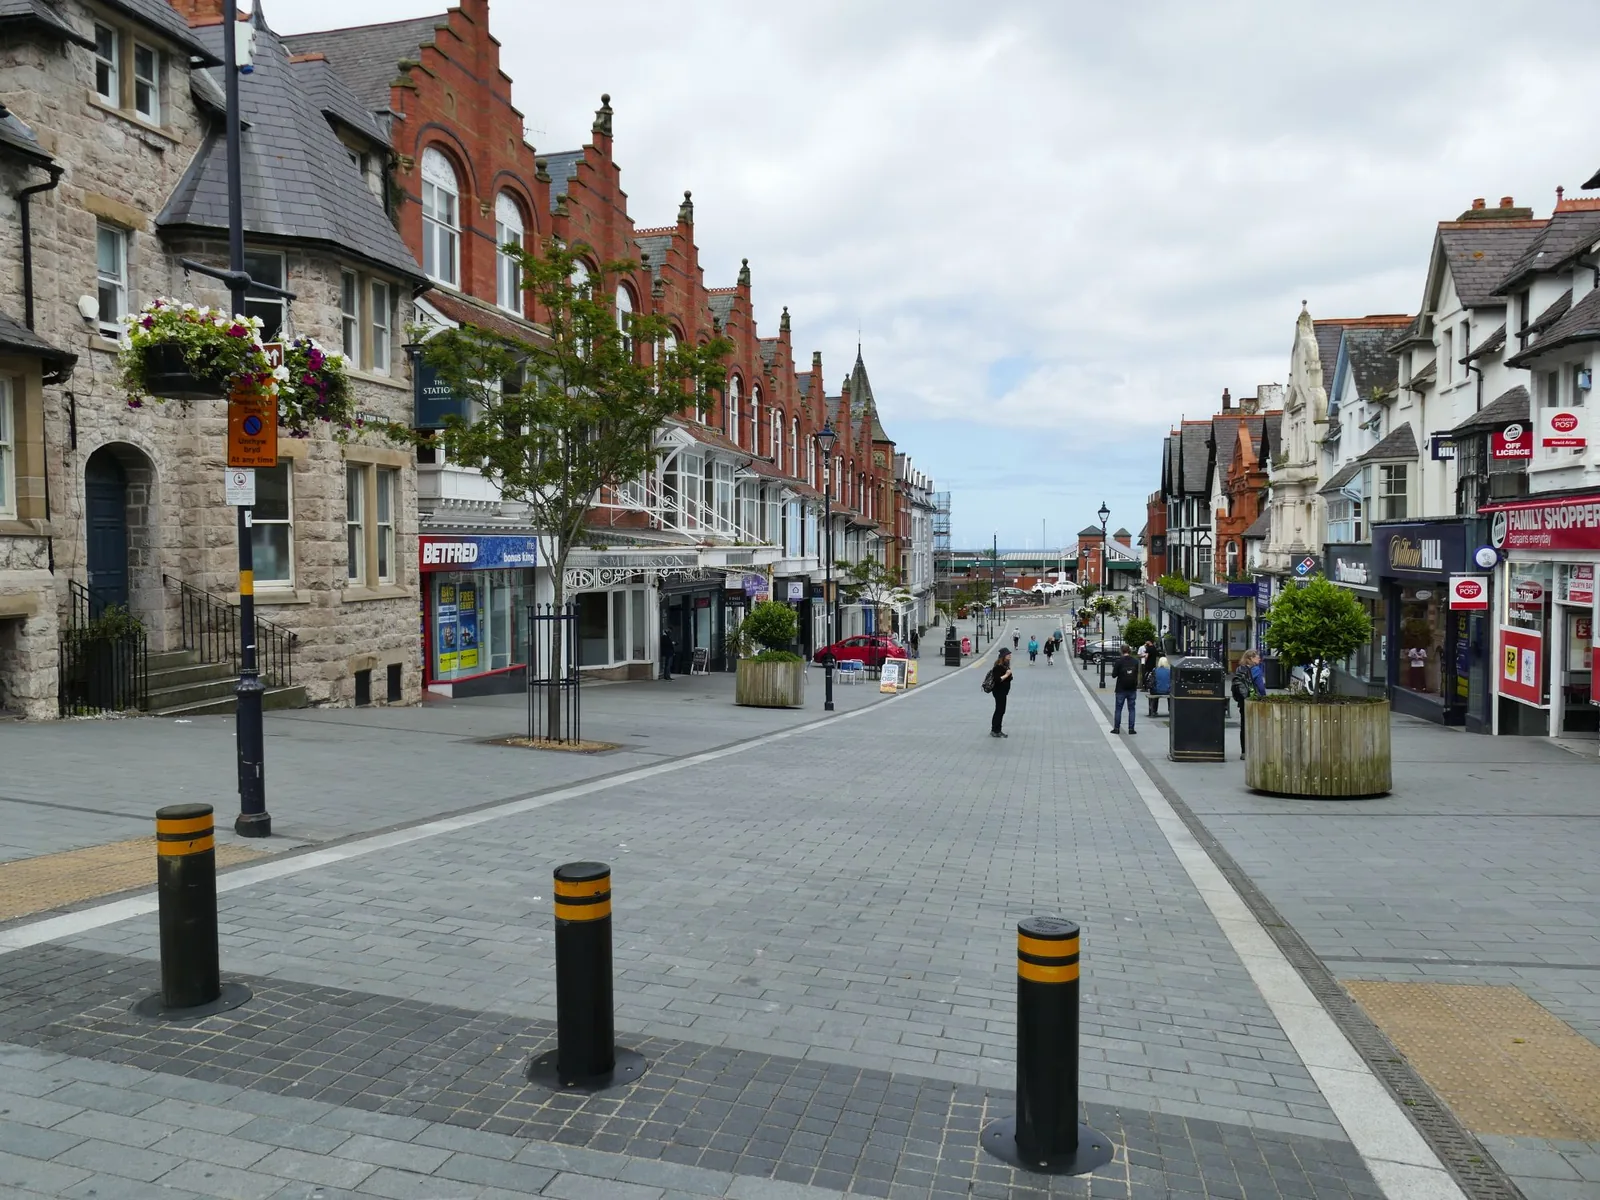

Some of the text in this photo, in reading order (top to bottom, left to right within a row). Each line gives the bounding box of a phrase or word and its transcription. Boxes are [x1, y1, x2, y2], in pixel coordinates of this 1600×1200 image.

[242, 456, 255, 464] any
[1509, 503, 1600, 531] FAMILY SHOPPER
[1509, 532, 1551, 547] Bargains everyday
[526, 541, 535, 550] the
[422, 542, 478, 564] BETFRED
[503, 552, 535, 563] bonus king
[1389, 535, 1443, 569] William HILL
[441, 586, 454, 597] BIG
[459, 591, 474, 601] FREE
[1213, 609, 1237, 619] @20
